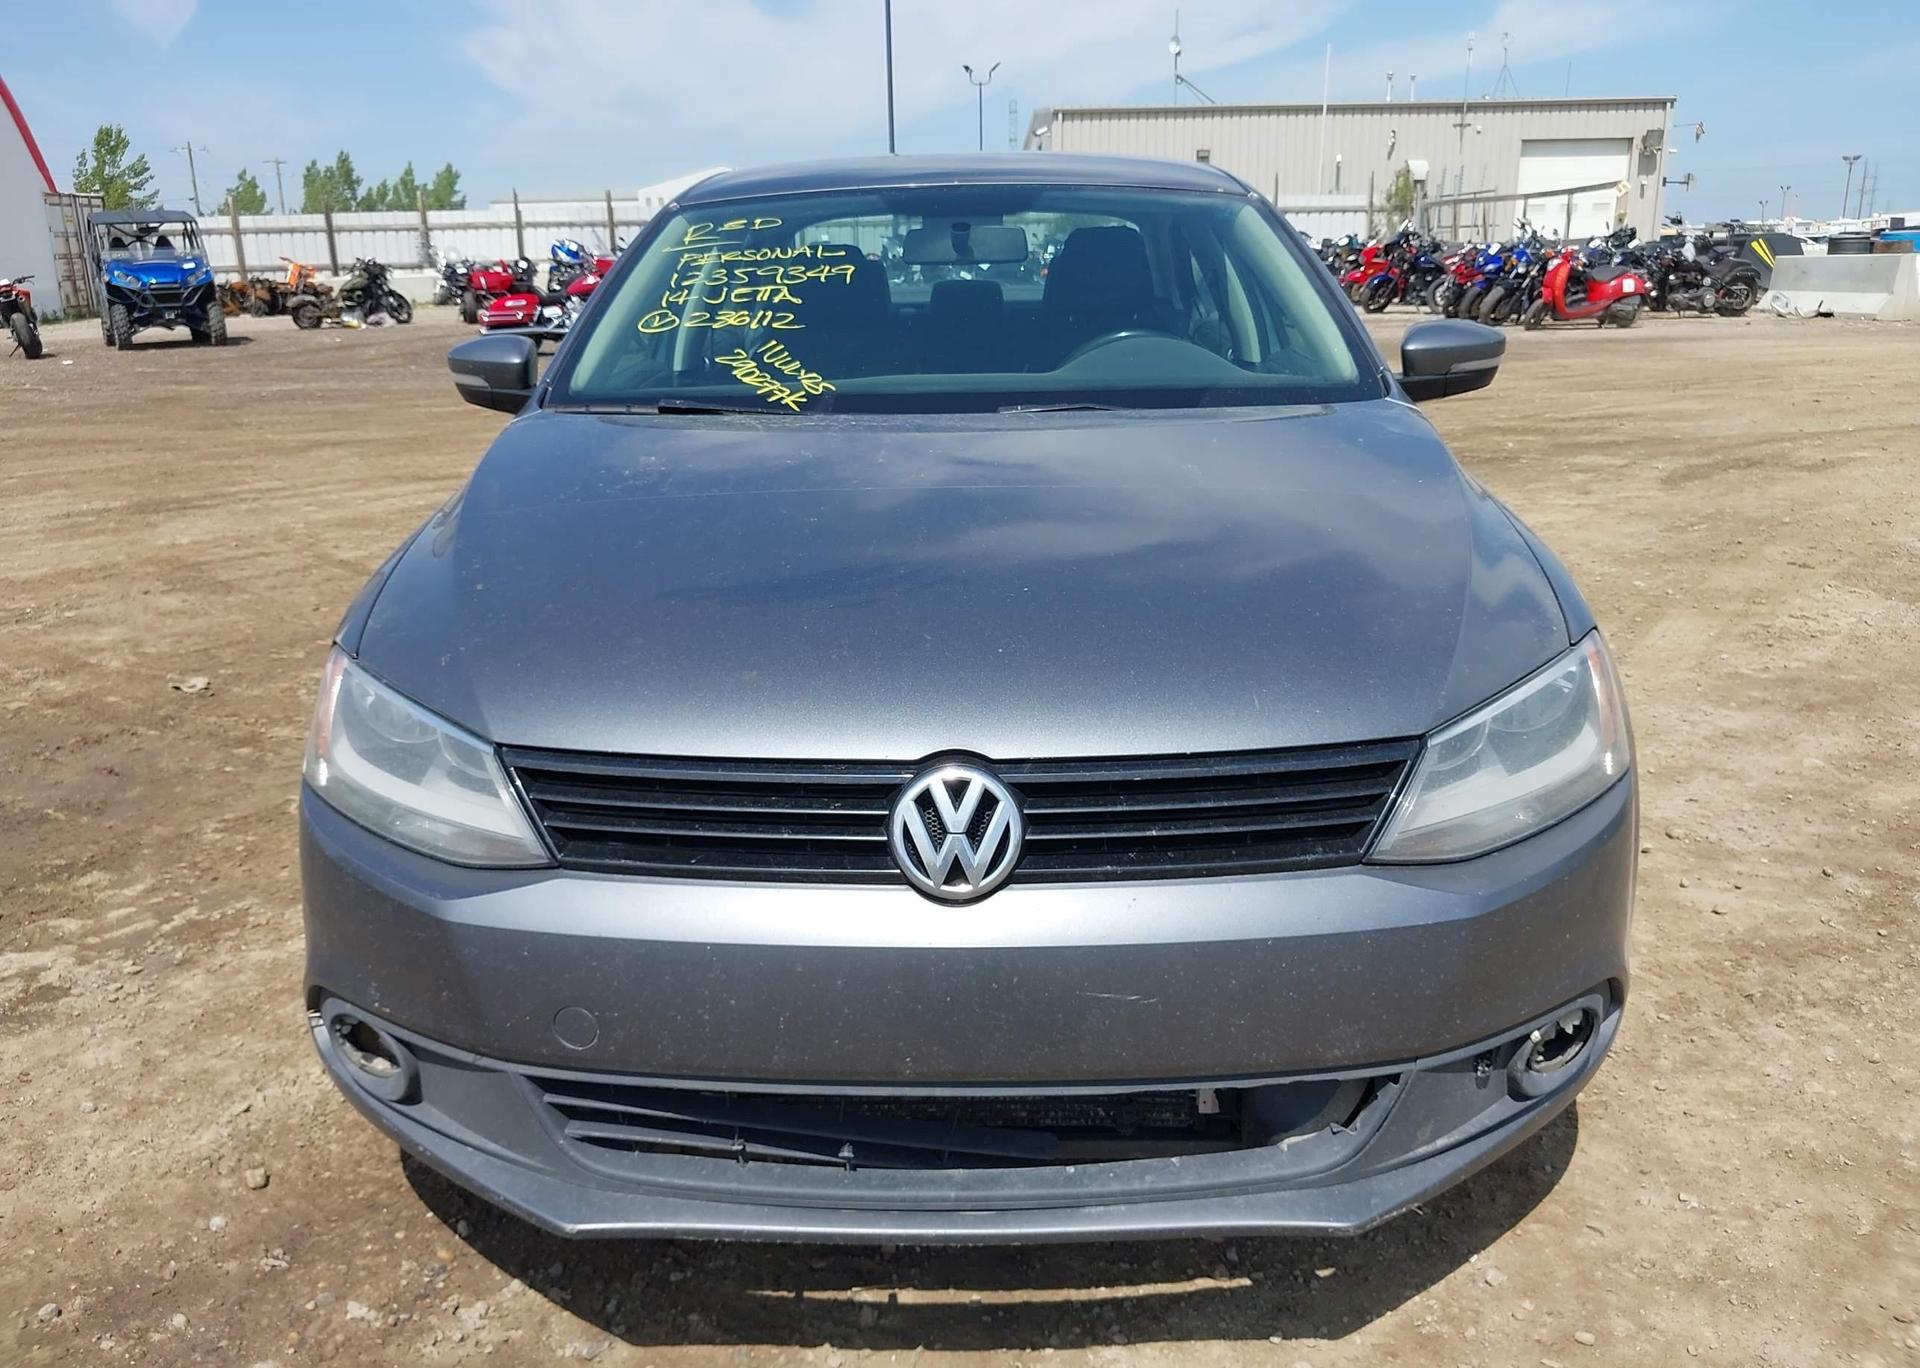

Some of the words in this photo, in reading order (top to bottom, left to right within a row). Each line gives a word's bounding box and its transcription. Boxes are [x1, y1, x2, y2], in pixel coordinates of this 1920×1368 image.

[669, 264, 857, 289] 12359349
[661, 289, 698, 308] 14
[702, 286, 803, 305] JETTA
[902, 777, 1012, 890] VW
